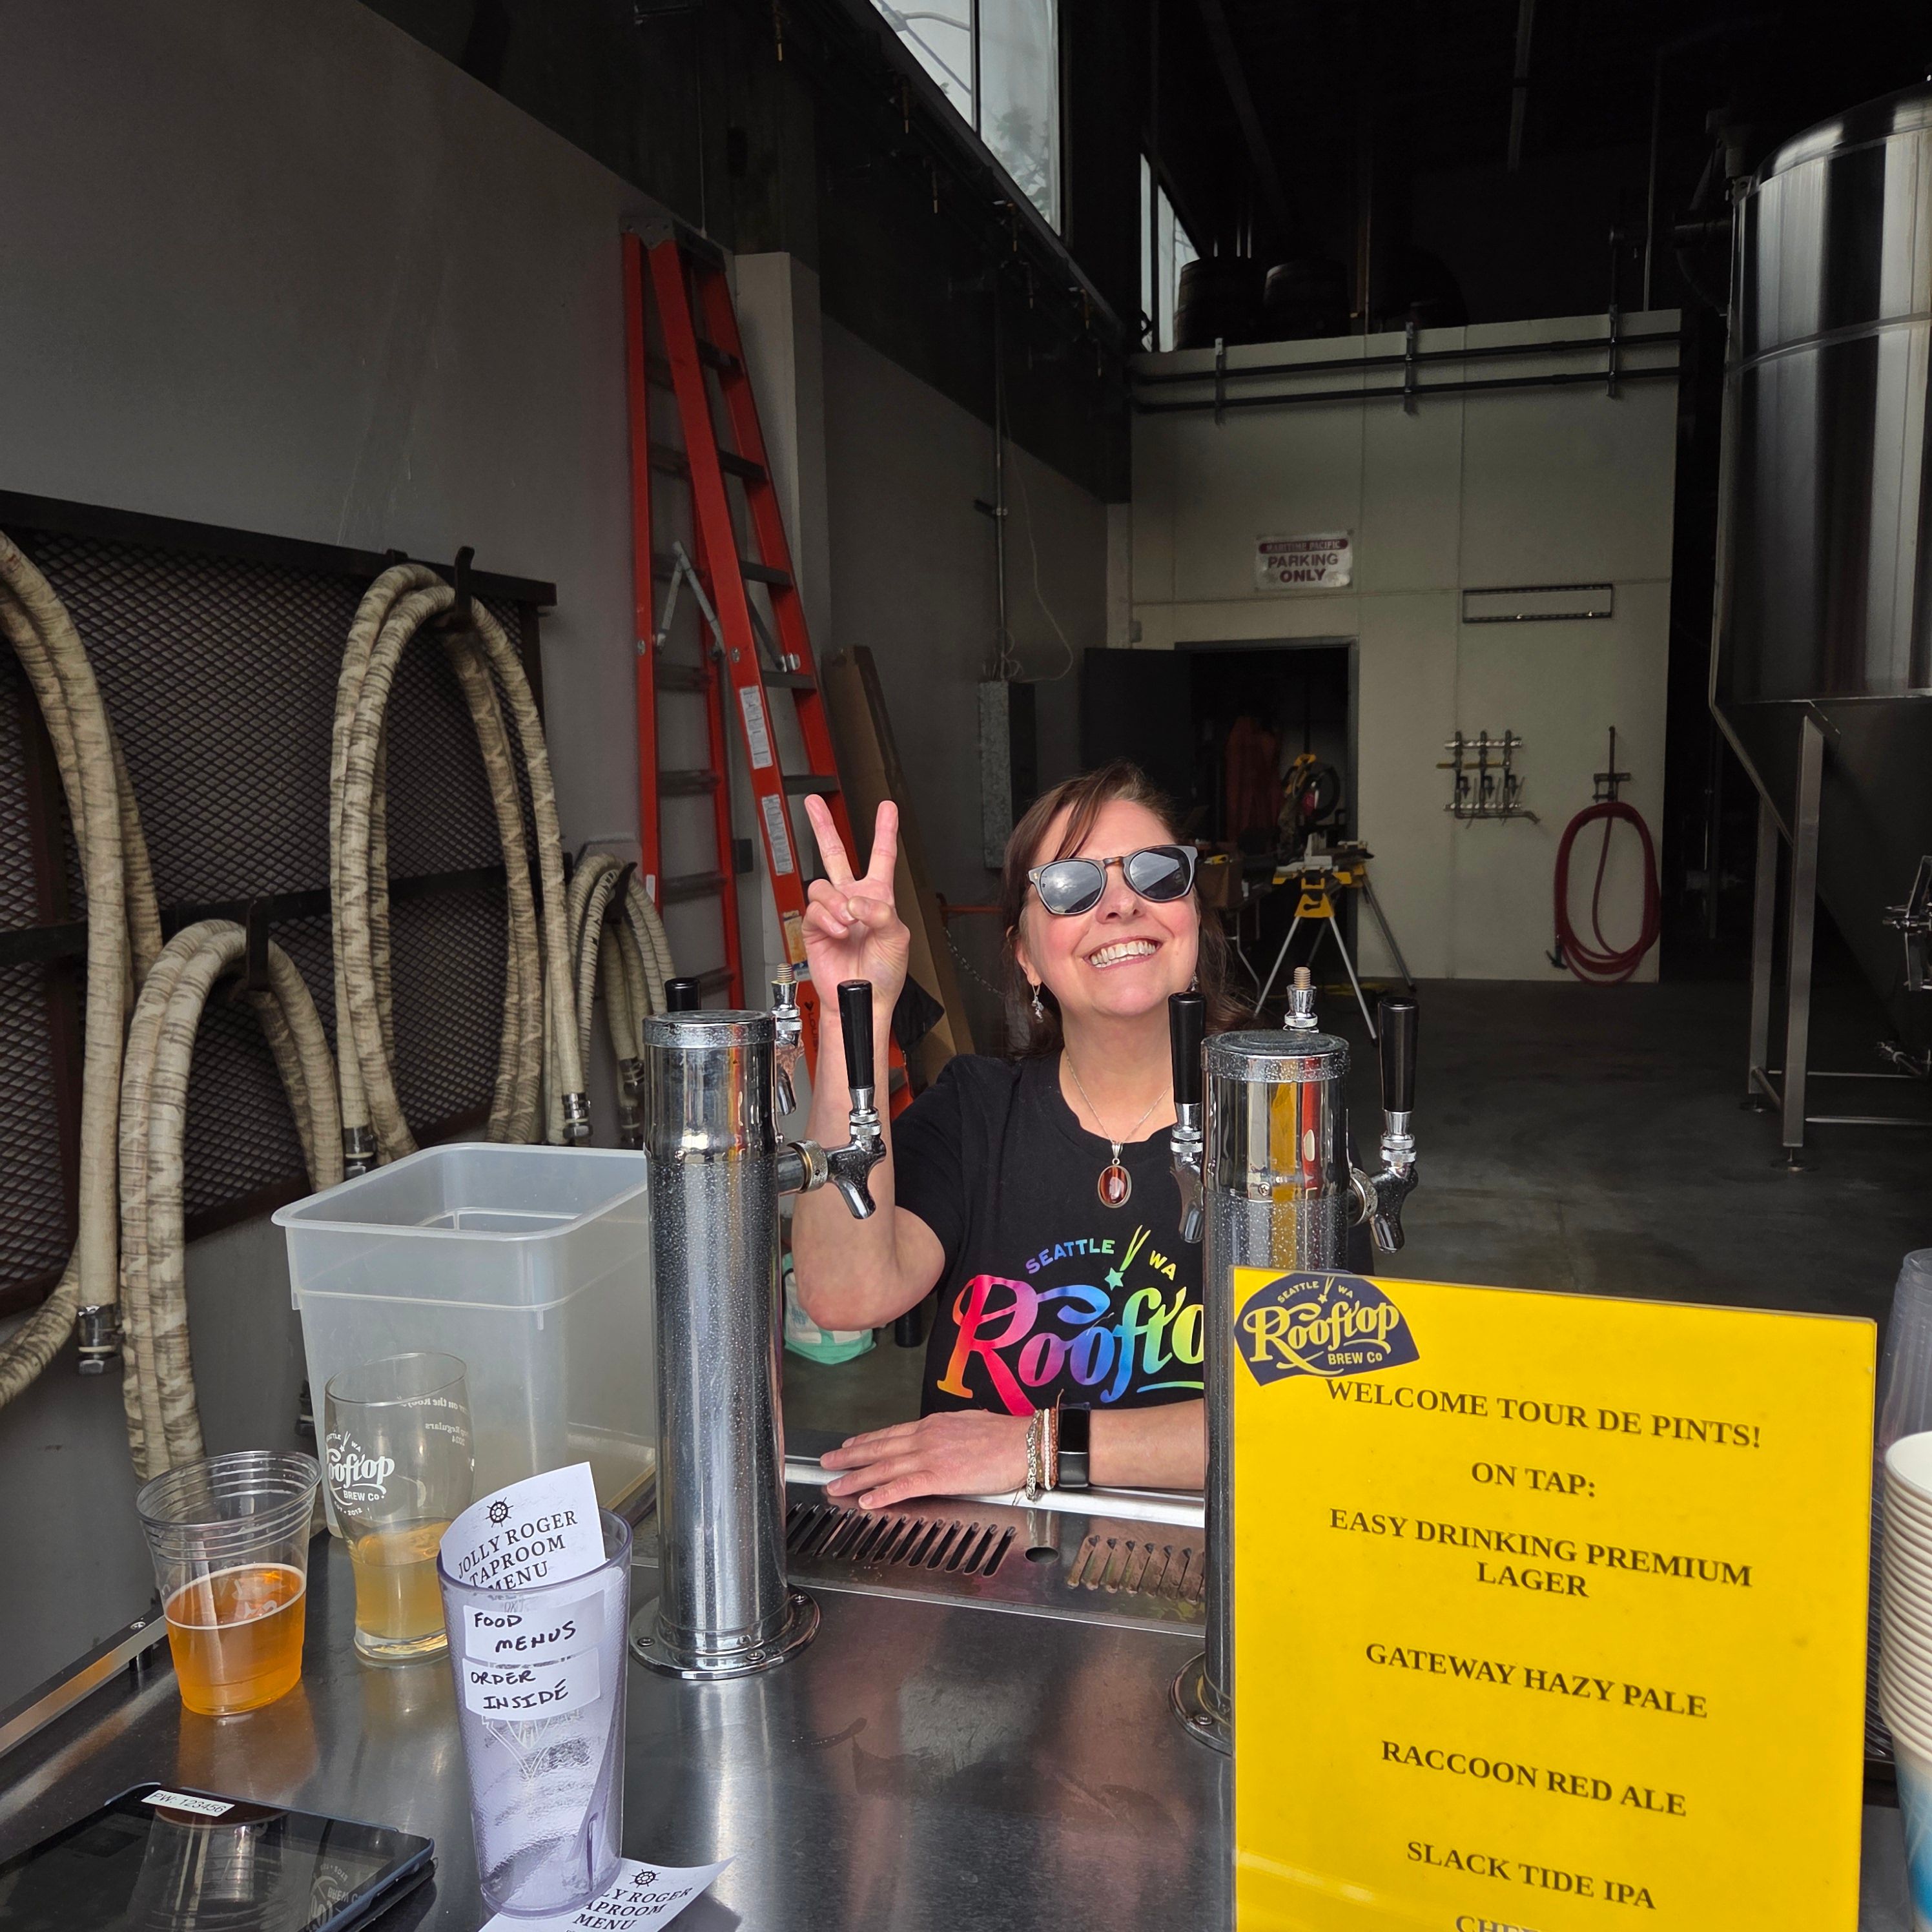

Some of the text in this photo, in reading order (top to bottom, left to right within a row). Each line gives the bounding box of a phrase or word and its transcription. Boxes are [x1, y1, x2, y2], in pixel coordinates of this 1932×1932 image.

[1309, 539, 1341, 549] PACIFIC
[1268, 553, 1338, 569] PARKING
[1279, 568, 1326, 583] ONLY
[1025, 1238, 1177, 1280] SEATTLE WA
[1277, 1280, 1353, 1304] SEATTLE WA
[937, 1274, 1204, 1417] Roofto
[1243, 1300, 1400, 1373] Rooftop
[1328, 1351, 1383, 1365] BREW Co
[1326, 1379, 1762, 1448] WELCOME TOUR DE PINTS!
[351, 1441, 362, 1453] WA
[1471, 1462, 1596, 1497] ON TAP:
[343, 1490, 380, 1501] BREW Co
[347, 1507, 363, 1516] 2012
[458, 1510, 578, 1579] JOLLY ROGER
[1330, 1508, 1752, 1587] EASY DRINKING PREMIUM
[469, 1534, 566, 1588] TAPROOM
[488, 1560, 548, 1590] MENU
[1477, 1561, 1590, 1598] LAGER
[474, 1612, 522, 1628] FOOD
[495, 1620, 576, 1653] MENUS
[471, 1670, 537, 1685] ORDER
[1365, 1643, 1709, 1720] GATEWAY HAZY PALE
[483, 1678, 569, 1710] INSIDE
[1381, 1740, 1688, 1818] RACCOON RED ALE
[149, 1793, 227, 1813] PW: 123456
[1407, 1841, 1658, 1910] SLACK TIDE IPA
[586, 1901, 667, 1917] APROOM
[626, 1887, 693, 1904] ROGER
[572, 1913, 637, 1931] MENU
